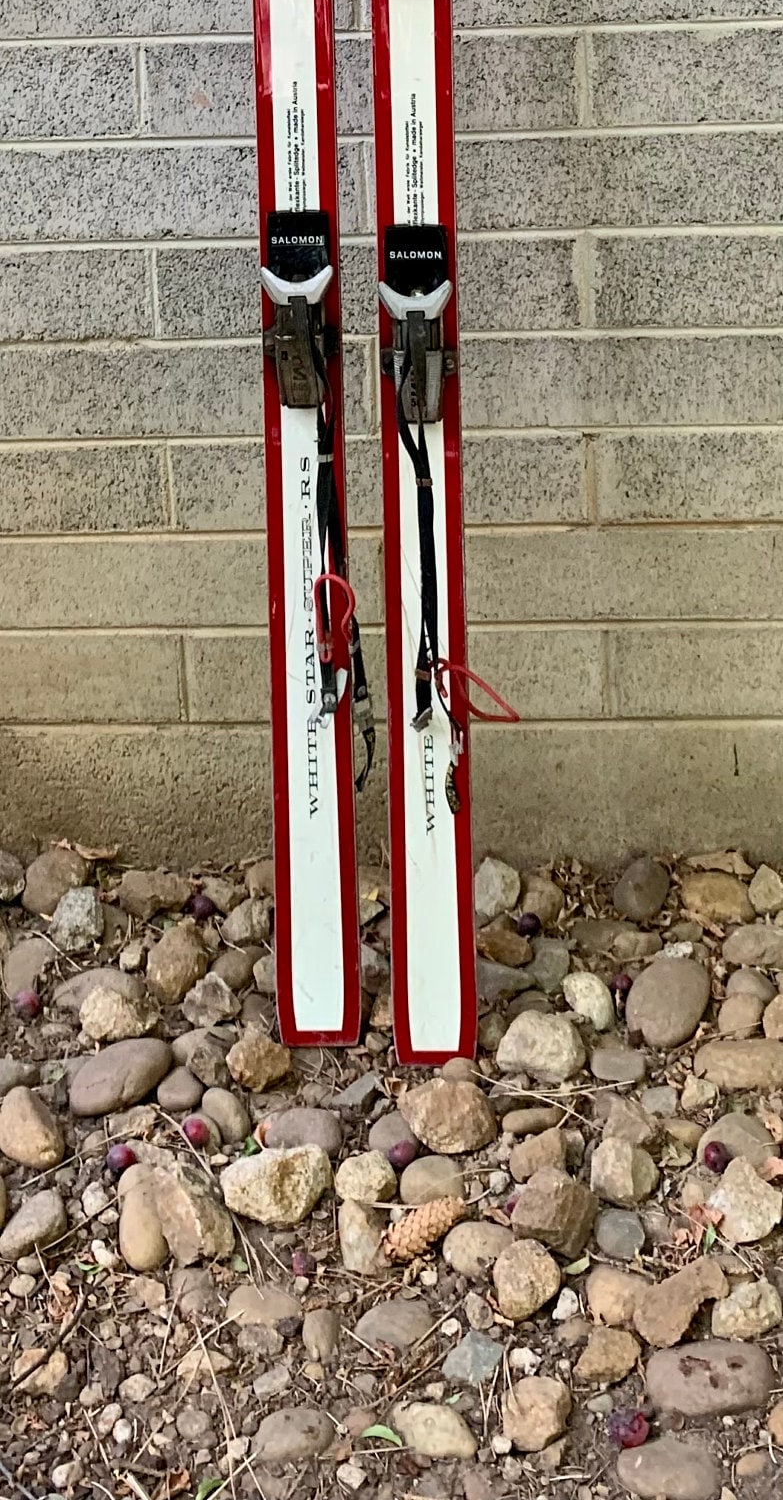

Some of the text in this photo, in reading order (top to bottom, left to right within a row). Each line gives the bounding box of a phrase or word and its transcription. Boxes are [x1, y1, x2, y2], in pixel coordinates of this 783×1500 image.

[271, 235, 324, 245] SALOMON
[389, 250, 443, 260] SALOMON
[301, 513, 313, 612] SUPER
[304, 628, 316, 704] STAR
[306, 719, 319, 820] WHITE
[423, 734, 436, 836] WHITE
